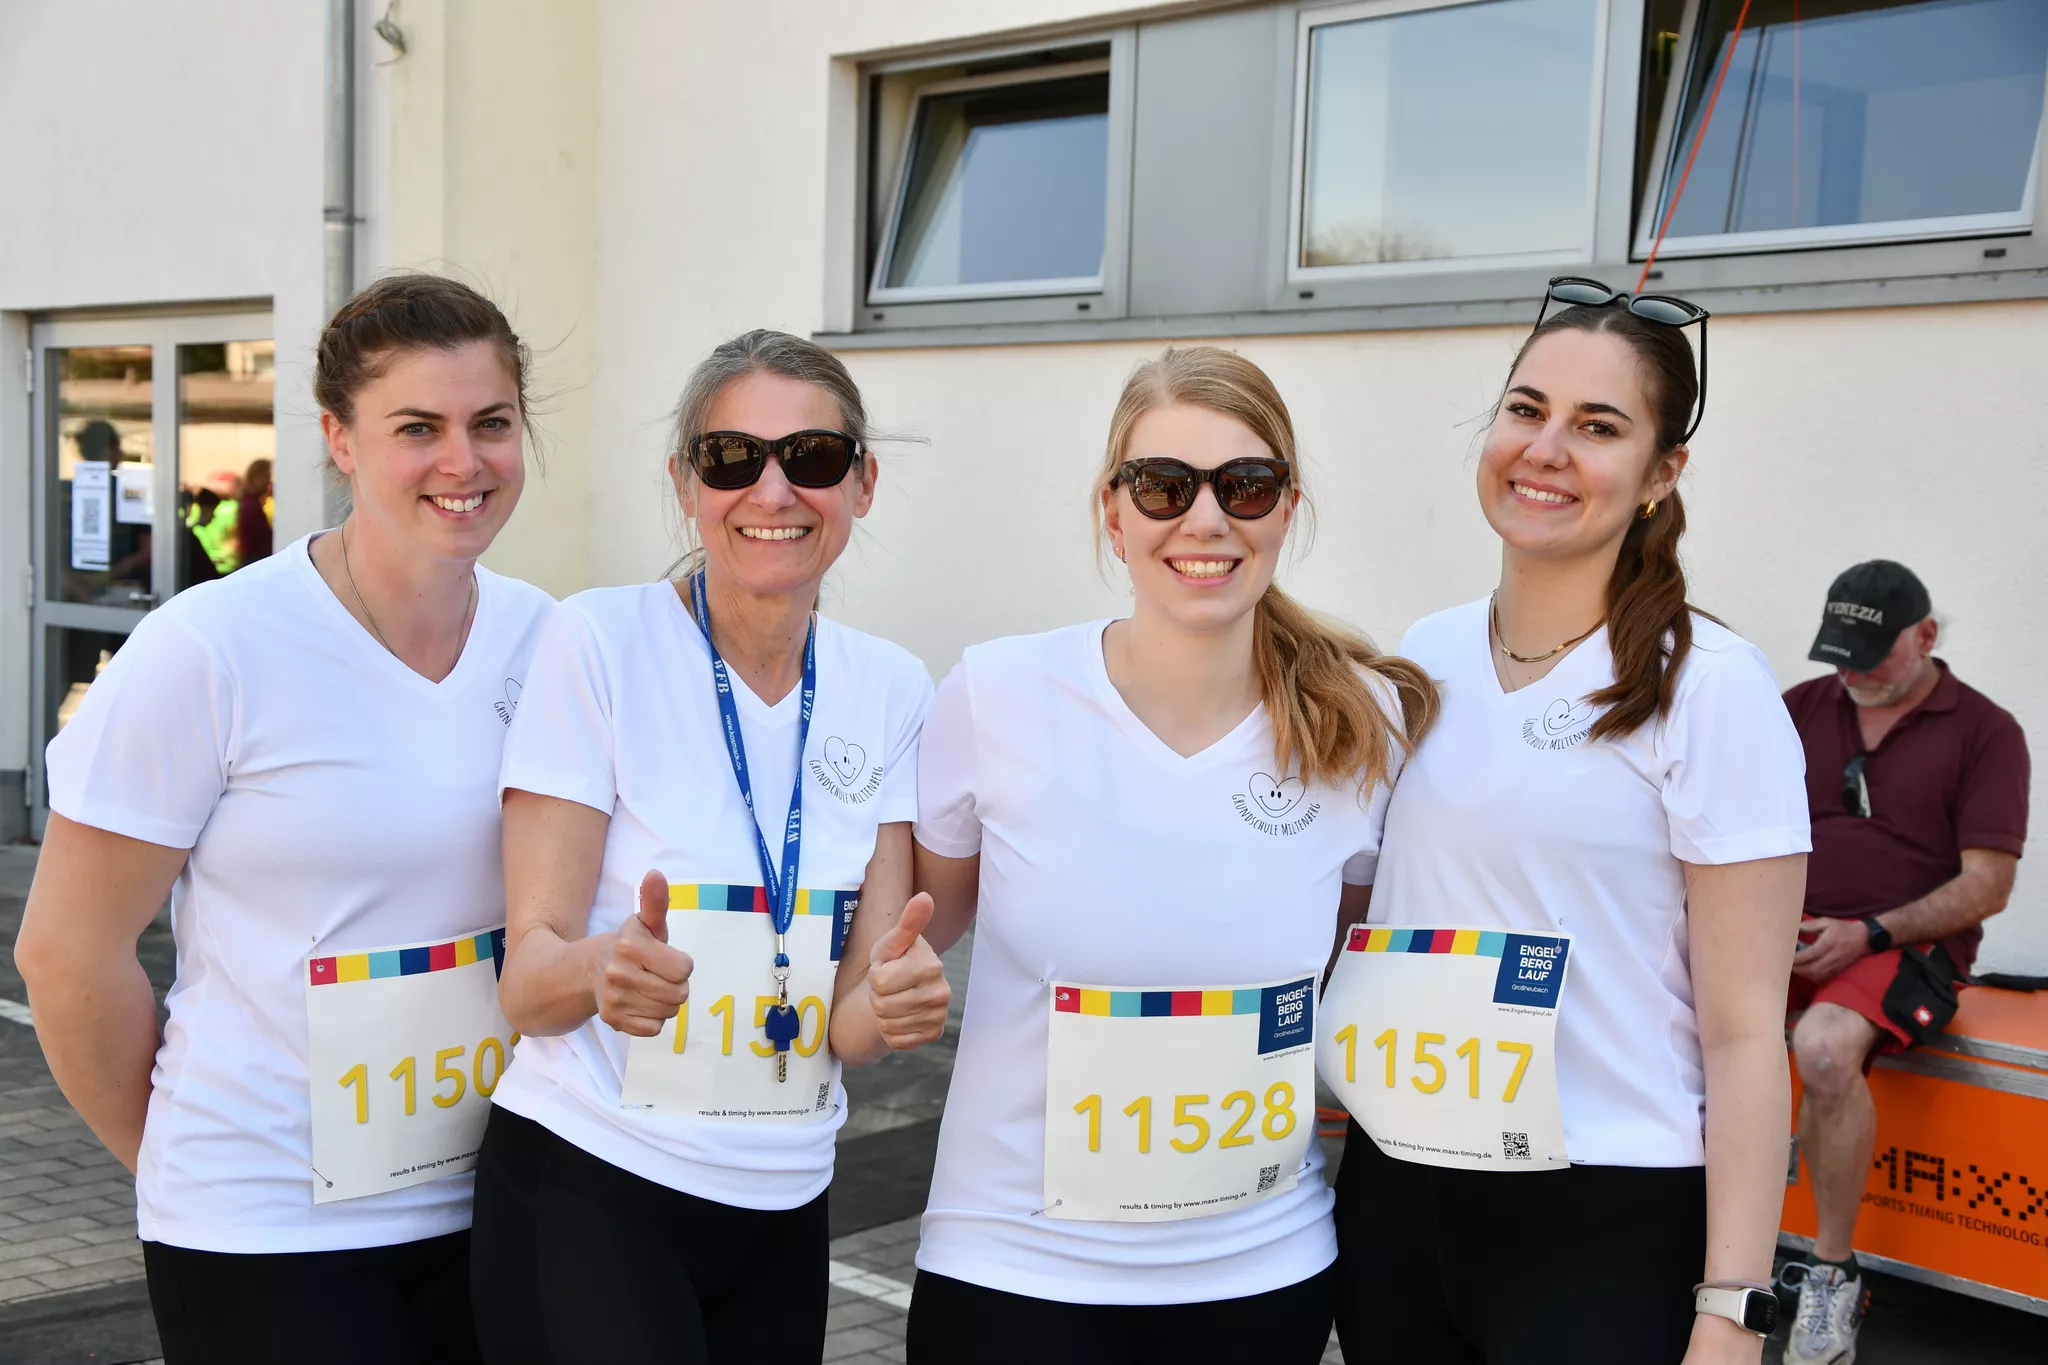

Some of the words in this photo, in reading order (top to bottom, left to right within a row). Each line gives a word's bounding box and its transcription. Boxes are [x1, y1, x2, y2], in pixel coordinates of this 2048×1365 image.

[1827, 601, 1884, 625] VENEZIA
[713, 659, 730, 694] WFB
[802, 689, 814, 721] WFB
[725, 713, 742, 771] www.kosmack.de
[808, 759, 849, 804] GRUNDSCHULE
[849, 766, 884, 804] MILTENBERG
[786, 808, 800, 845] WFB
[1231, 793, 1278, 836] GRUNDSCHULE
[1280, 802, 1321, 836] MILTENBERG
[783, 864, 795, 924] www.kosmack.de
[1519, 944, 1558, 959] ENGEL
[1519, 957, 1553, 970] BERG
[1517, 968, 1549, 981] LAUF
[1276, 988, 1306, 1005] ENGEL
[1277, 1000, 1303, 1016] BERG
[1277, 1011, 1303, 1027] LAUF
[1333, 1023, 1533, 1103] 11517
[337, 1031, 521, 1125] 1150
[698, 1109, 721, 1117] results
[721, 1109, 727, 1117] &
[728, 1109, 747, 1118] timing
[748, 1109, 756, 1118] by
[756, 1107, 810, 1117] www.maxx-timing.de
[1072, 1080, 1297, 1154] 11528
[1392, 1139, 1398, 1147] &
[1398, 1141, 1416, 1151] timing
[1417, 1144, 1425, 1152] by
[1425, 1146, 1493, 1159] www.maxx-timing.de
[389, 1168, 410, 1178] results
[411, 1165, 417, 1173] &
[417, 1161, 437, 1171] timing
[437, 1159, 445, 1167] by
[1150, 1203, 1172, 1211] timing
[1173, 1202, 1183, 1210] by
[1183, 1191, 1248, 1208] www.maxx-timing.de
[1908, 1201, 1955, 1226] TIMING
